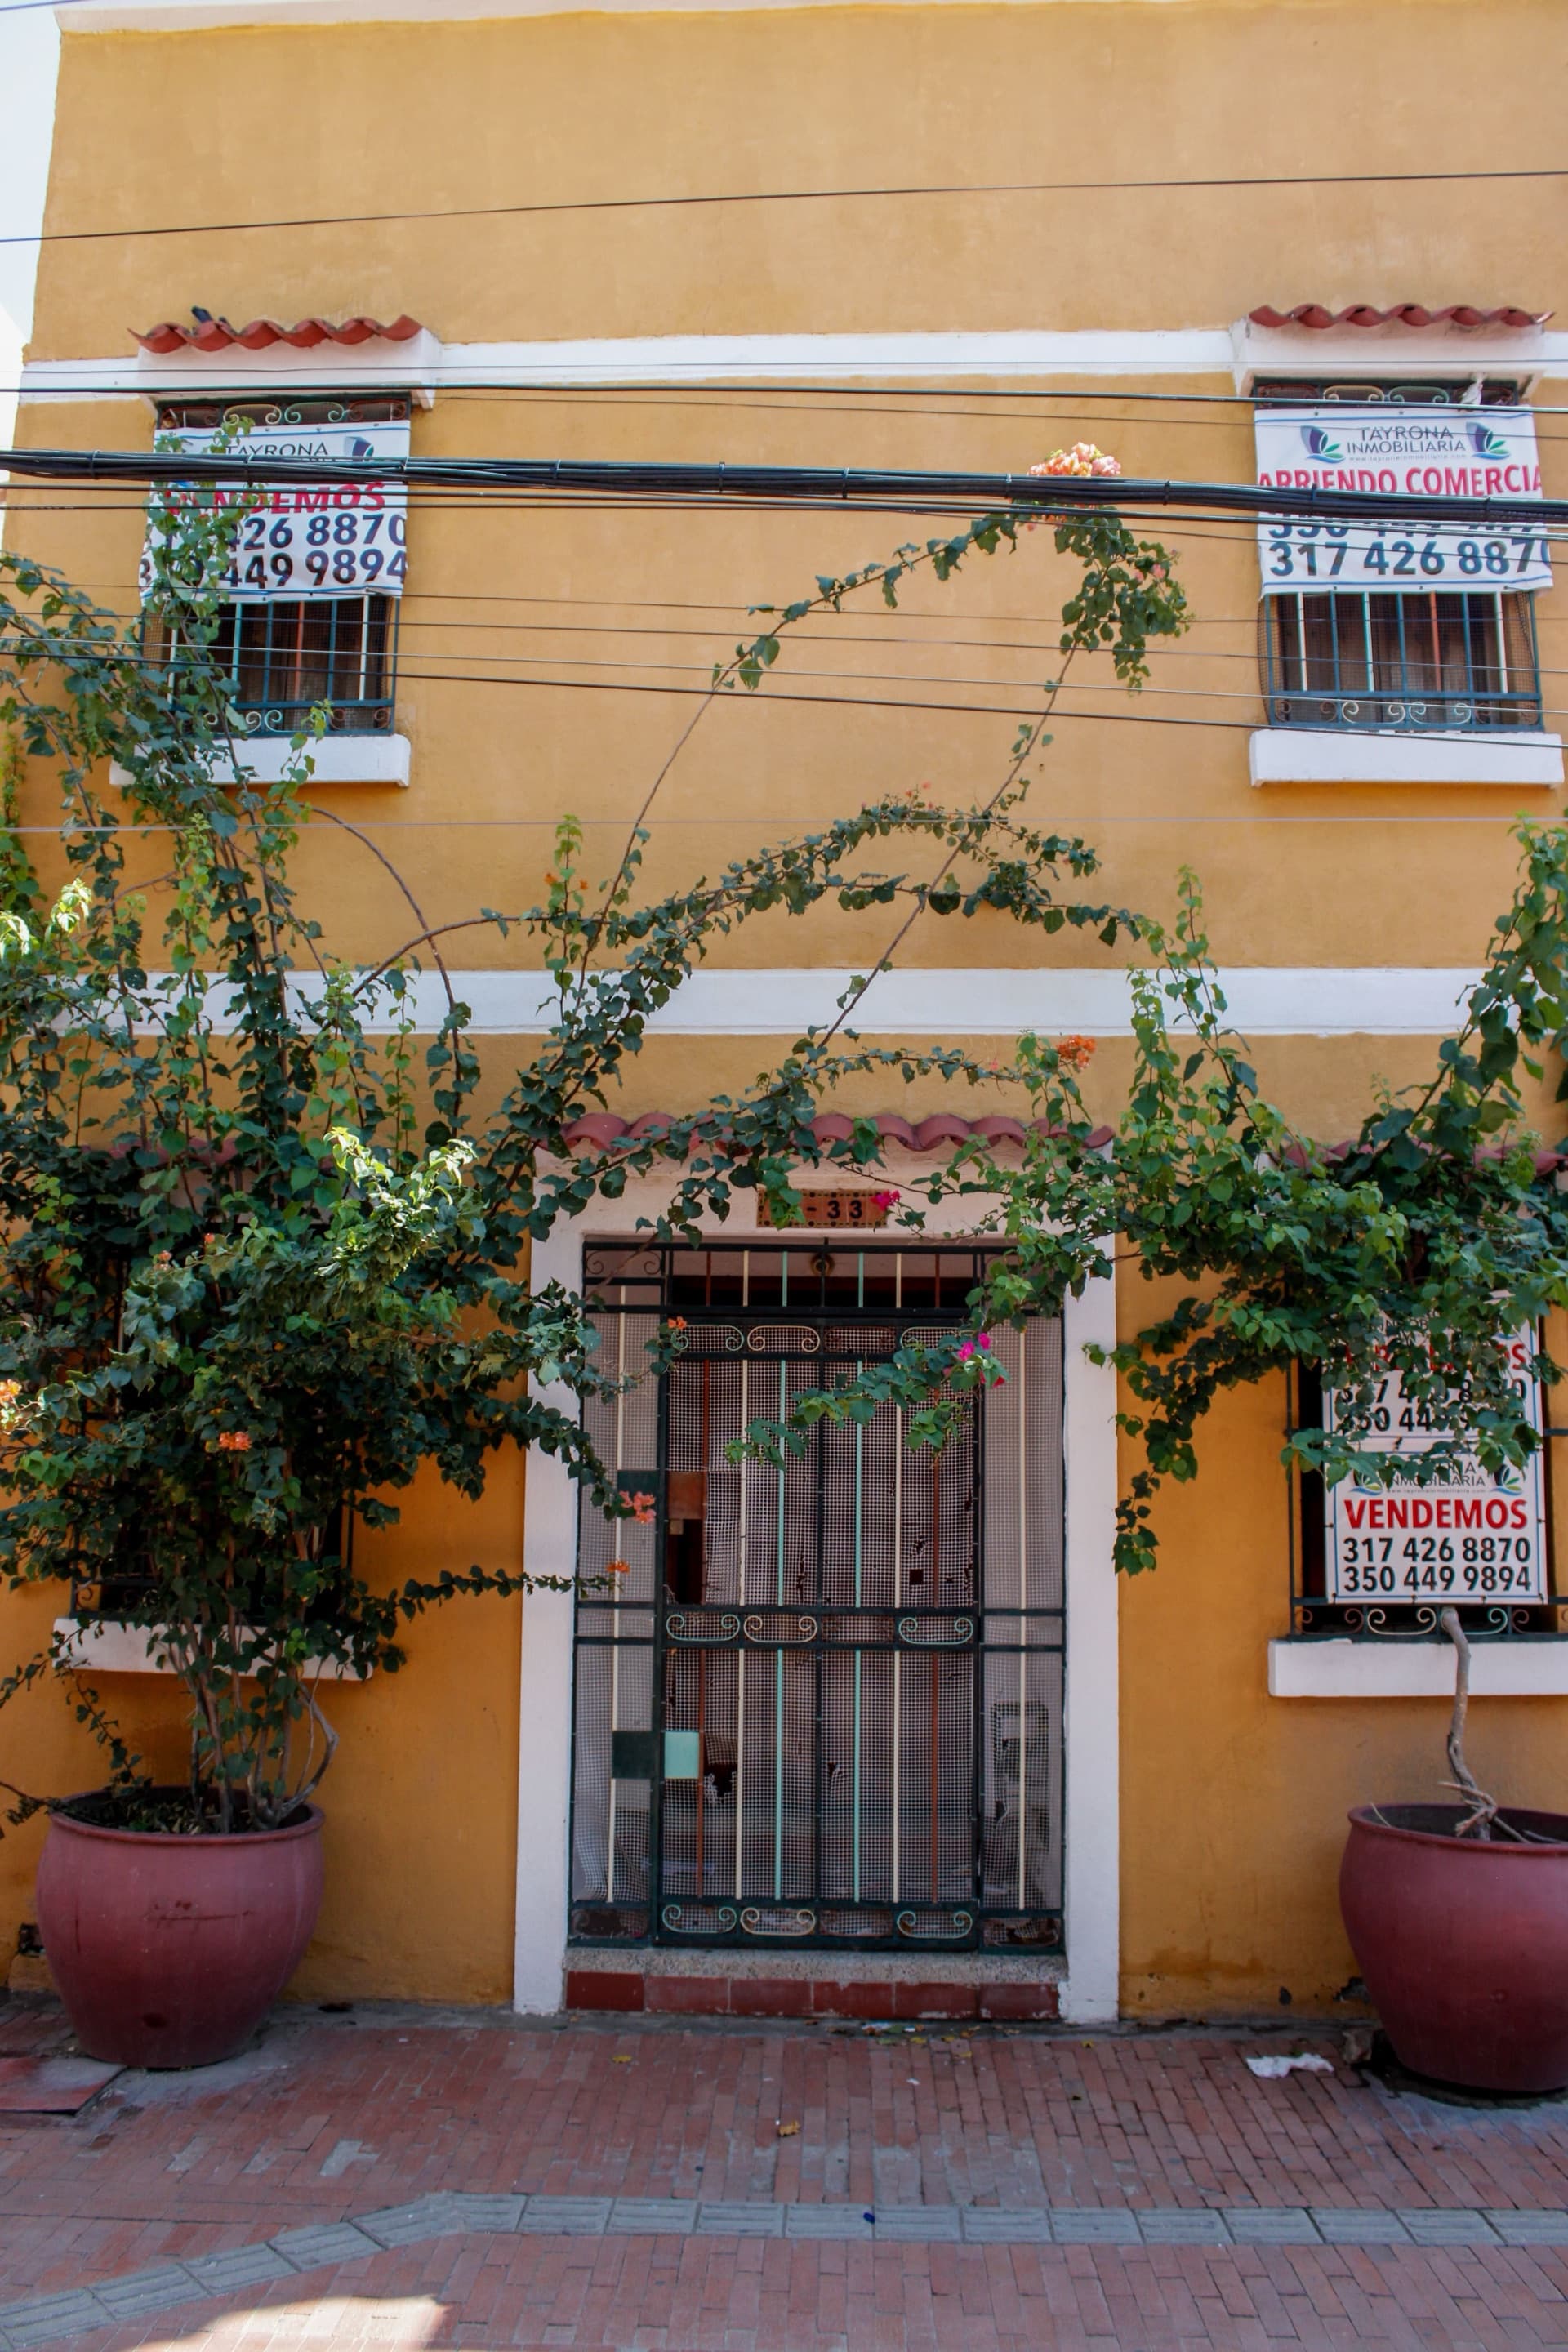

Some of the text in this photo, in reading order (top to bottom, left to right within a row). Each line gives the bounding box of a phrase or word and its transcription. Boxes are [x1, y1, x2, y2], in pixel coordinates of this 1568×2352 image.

[1348, 440, 1466, 454] INMOBILIARIA
[1361, 425, 1454, 441] TAYRONA
[306, 513, 406, 546] 8870
[305, 548, 407, 586] 9894
[1269, 541, 1348, 577] 317
[1363, 541, 1446, 576] 426
[1344, 1499, 1528, 1530] VENDEMOS
[1343, 1537, 1531, 1563] 317 426 8870
[1344, 1566, 1532, 1592] 350 449 9894
